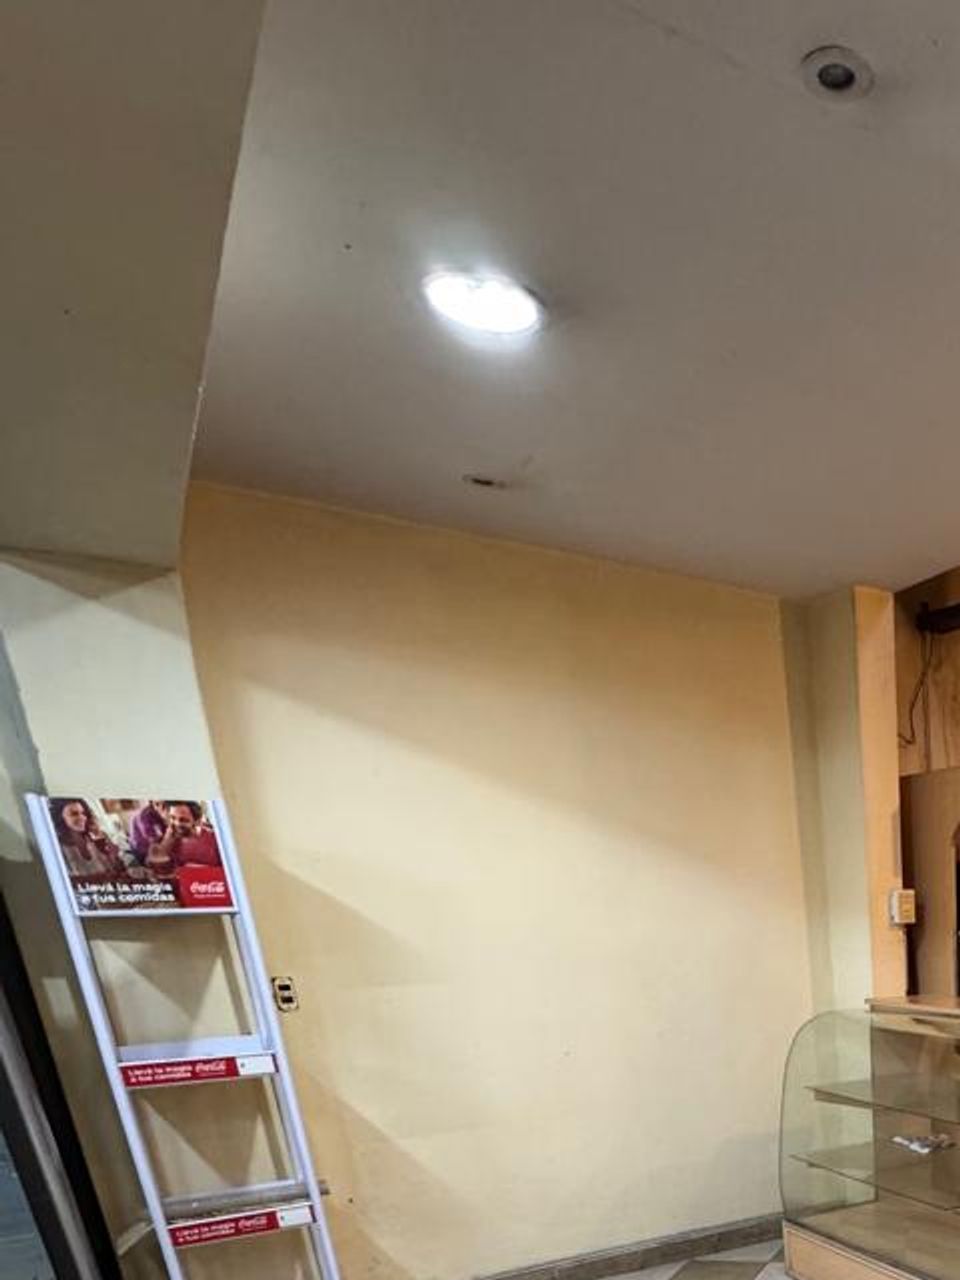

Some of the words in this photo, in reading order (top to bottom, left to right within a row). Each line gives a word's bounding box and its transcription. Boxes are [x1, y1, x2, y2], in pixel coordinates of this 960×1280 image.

[117, 882, 131, 892] la
[133, 881, 173, 894] magia
[94, 893, 117, 904] tus
[118, 892, 176, 903] comidas
